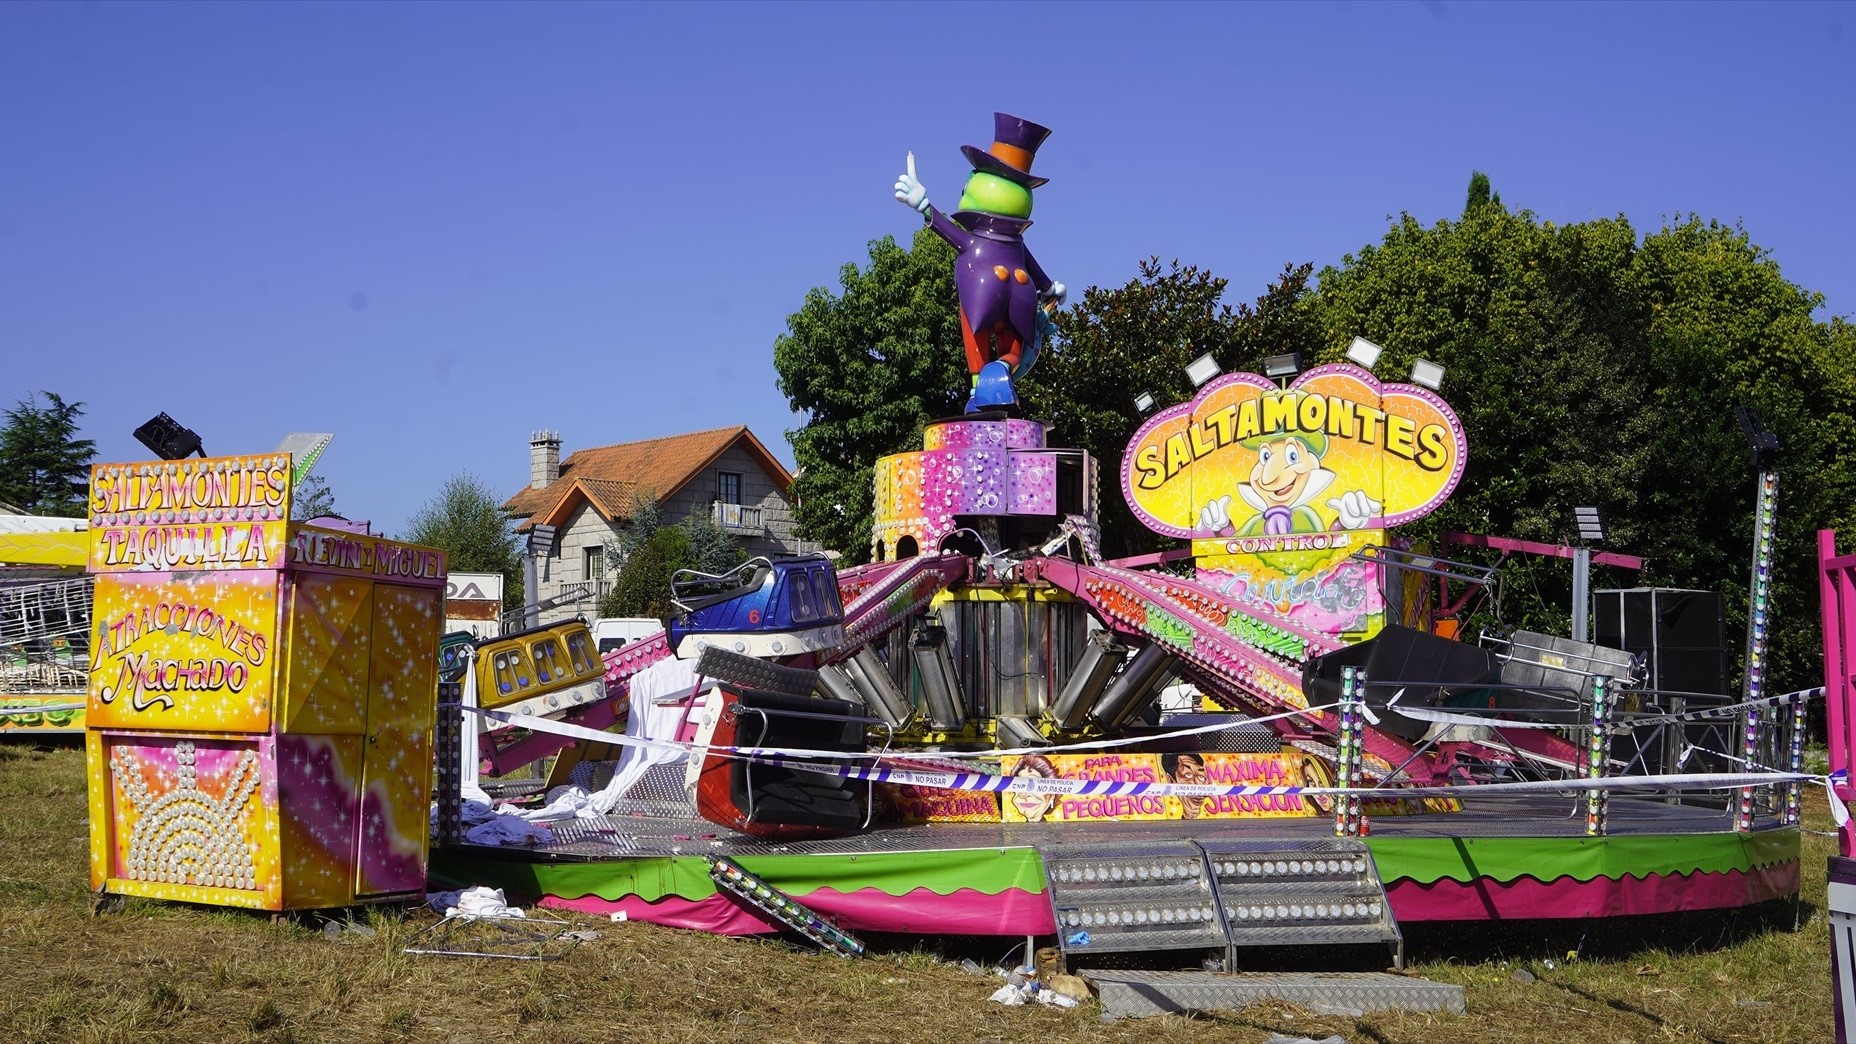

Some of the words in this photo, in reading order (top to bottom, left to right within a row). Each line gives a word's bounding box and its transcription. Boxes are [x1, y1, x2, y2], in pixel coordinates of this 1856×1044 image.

[1134, 392, 1449, 490] SALTAMONTES
[92, 465, 286, 514] SALTAMONTES
[101, 524, 269, 570] TAQUILLA
[293, 530, 364, 570] KEVIN
[373, 543, 448, 580] MIGUEL
[1226, 534, 1348, 554] CONTROL
[748, 609, 761, 624] 6
[90, 600, 269, 673] ATRACCIONES
[1487, 696, 1496, 709] 8
[1085, 755, 1122, 770] PARA
[1205, 759, 1285, 784] MAXIMA
[926, 777, 947, 785] PASAR
[1048, 786, 1072, 794] PASAR
